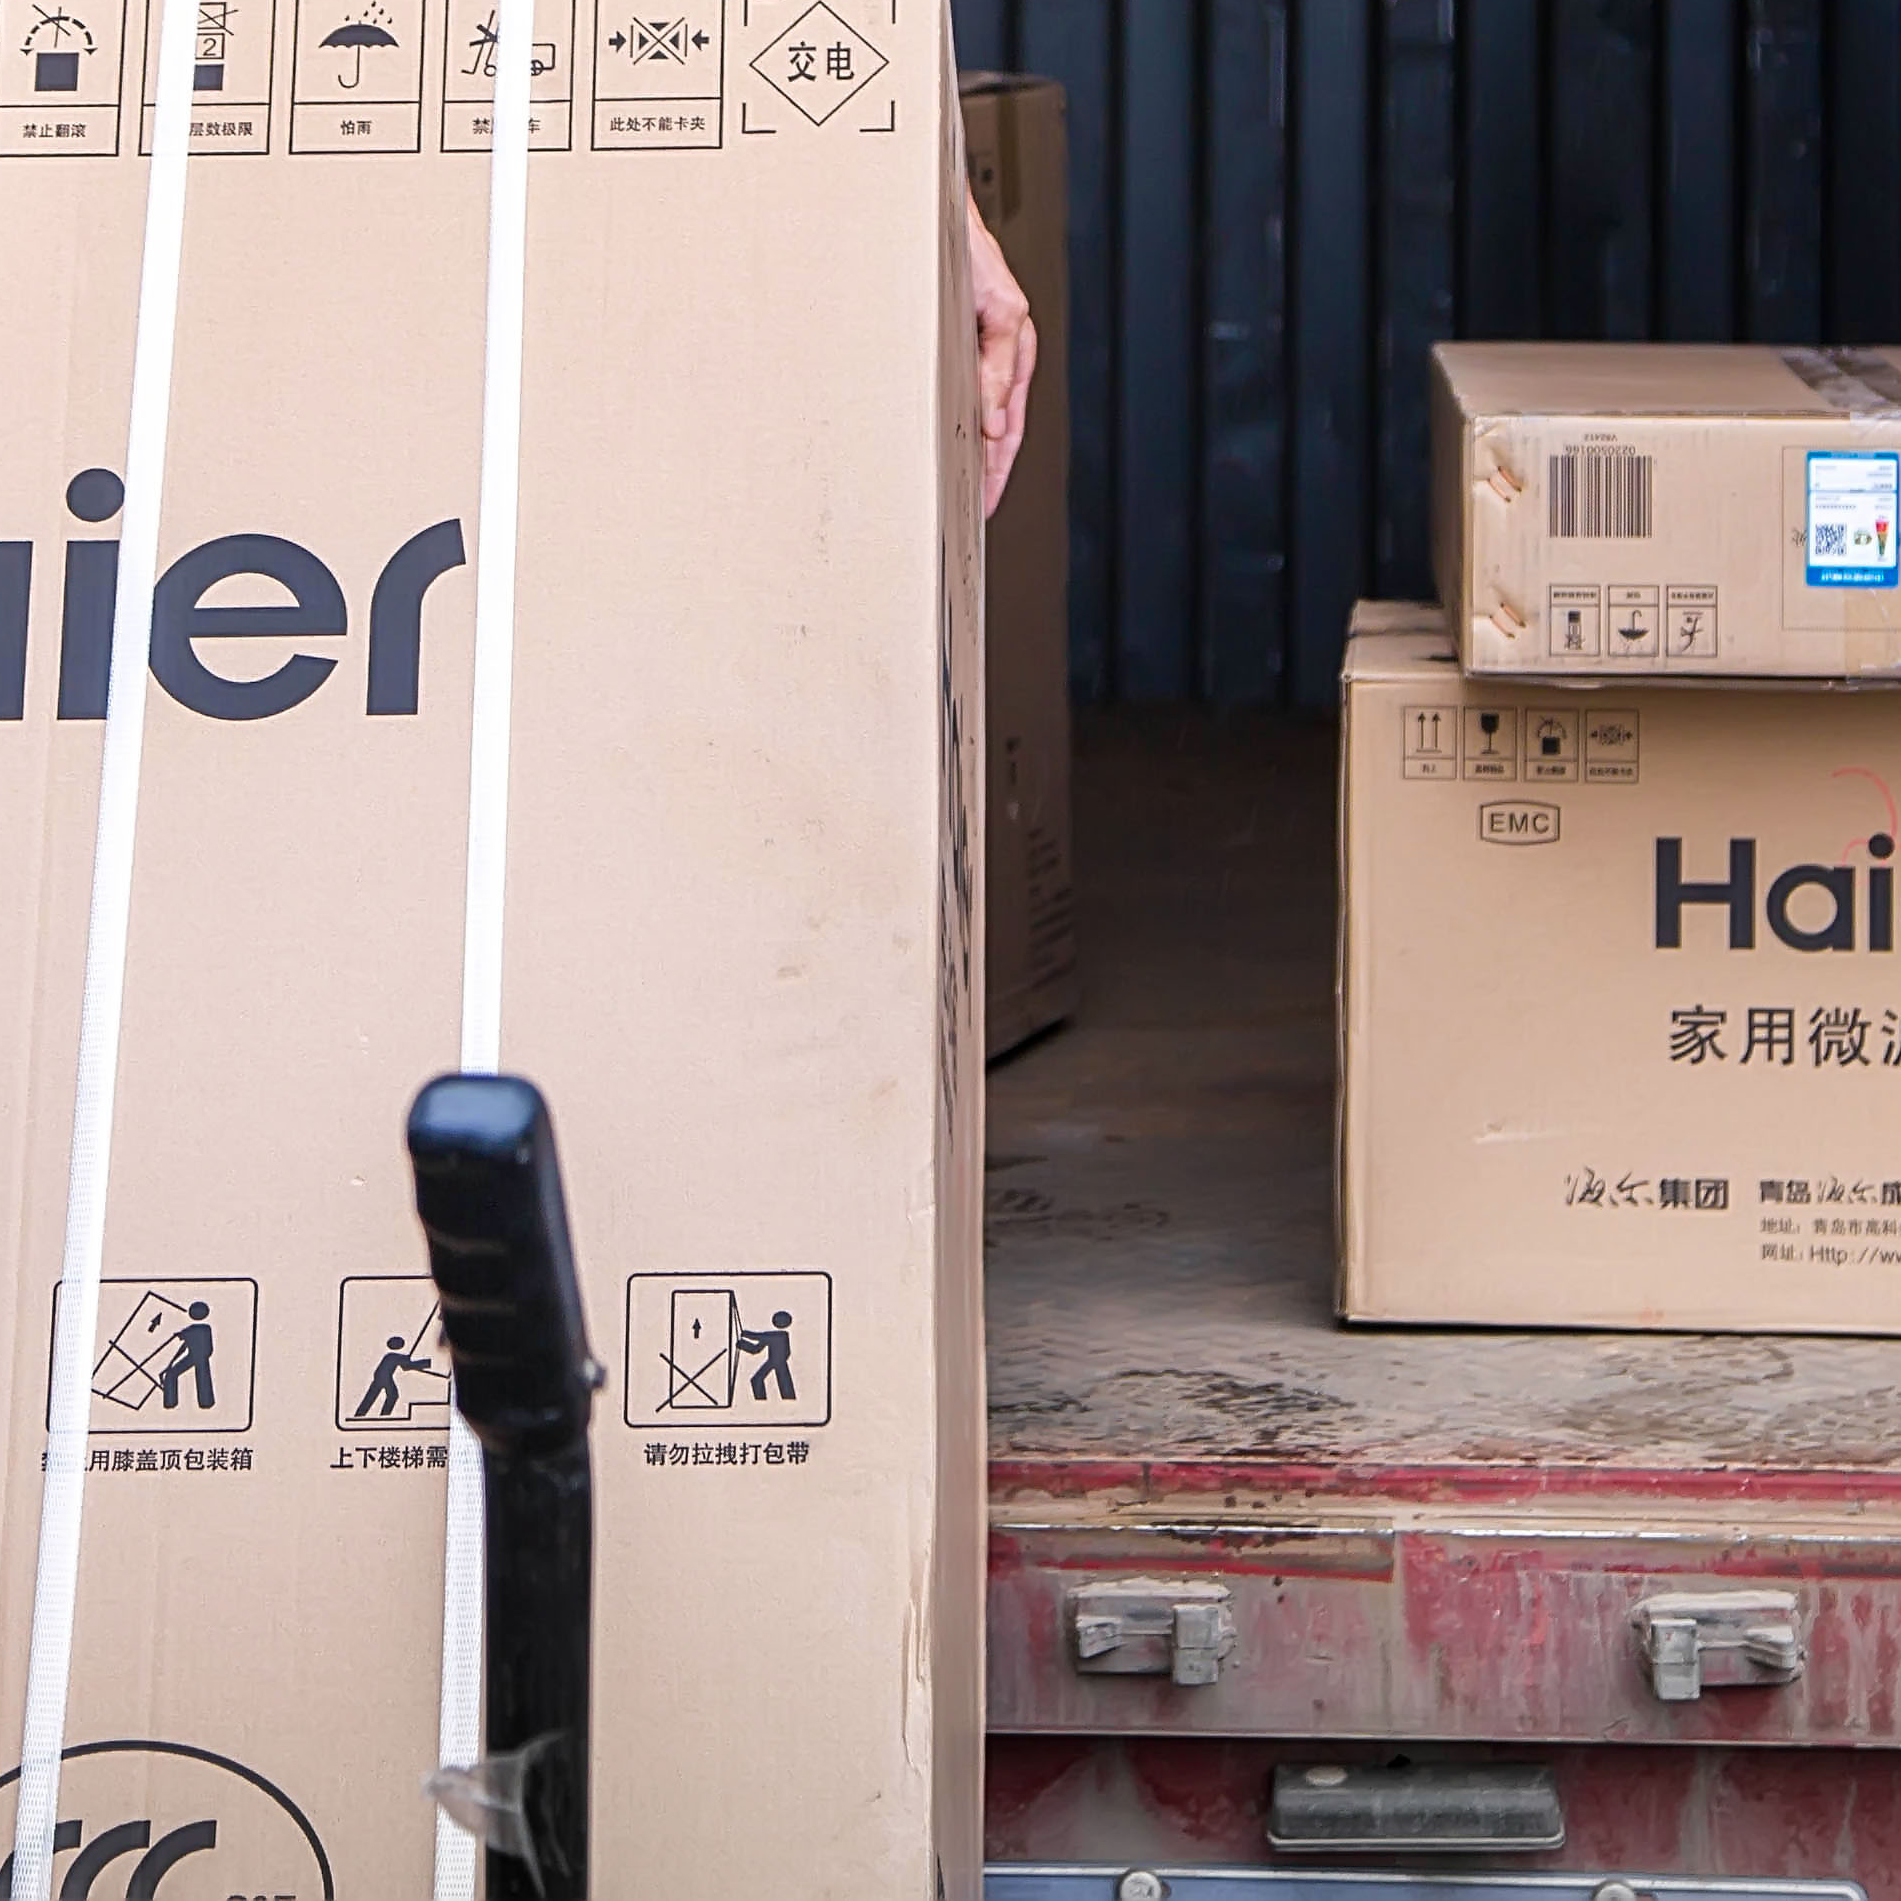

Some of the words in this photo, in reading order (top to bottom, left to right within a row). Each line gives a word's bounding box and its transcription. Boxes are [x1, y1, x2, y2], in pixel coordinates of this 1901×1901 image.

[203, 36, 217, 57] 2
[787, 39, 855, 83] 交电
[23, 123, 86, 140] 禁止翻滚
[340, 119, 372, 135] 怕雨
[472, 116, 541, 135] 禁车
[609, 114, 705, 133] 此处不能卡夹
[1489, 812, 1550, 834] EMC
[41, 1447, 254, 1474] 用膝盖顶包装箱
[329, 1446, 449, 1470] 上下楼梯需
[643, 1440, 811, 1466] 请勿拉拽打包带
